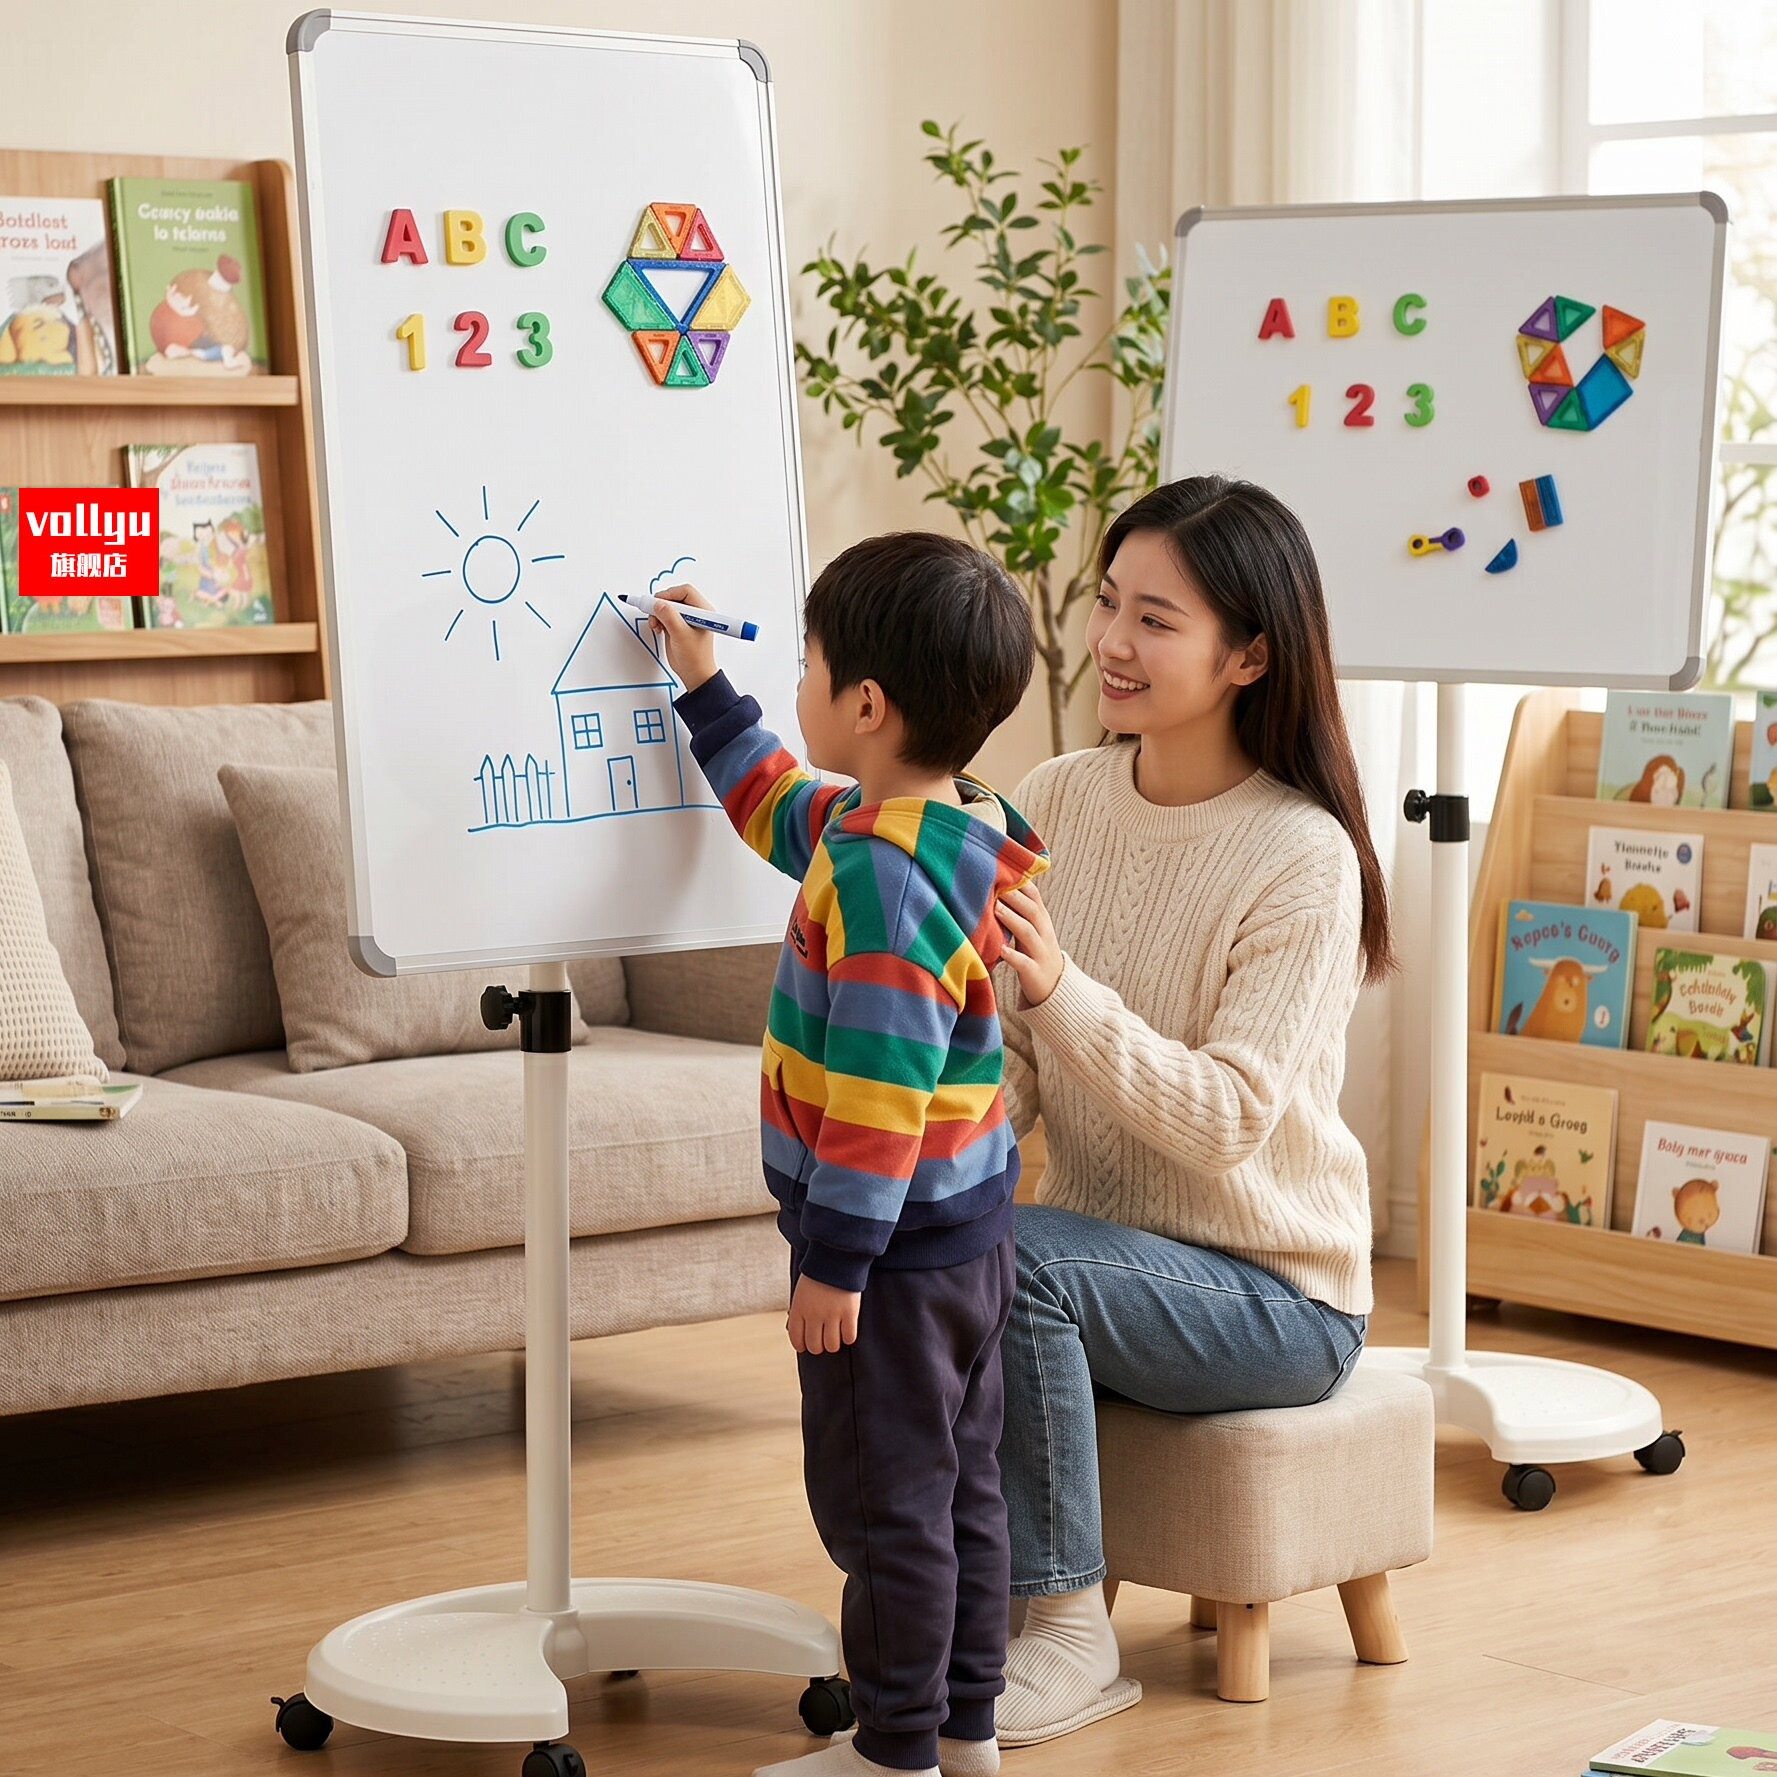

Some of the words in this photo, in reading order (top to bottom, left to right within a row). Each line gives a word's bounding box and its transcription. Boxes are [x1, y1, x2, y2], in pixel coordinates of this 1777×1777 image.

[1257, 298, 1295, 339] A
[1327, 296, 1360, 338] B
[1392, 293, 1427, 336] C
[396, 313, 426, 371] 1
[453, 311, 492, 367] 2
[516, 312, 553, 368] 3
[1288, 384, 1311, 428] 1
[1343, 383, 1375, 427] 2
[1404, 383, 1434, 427] 3
